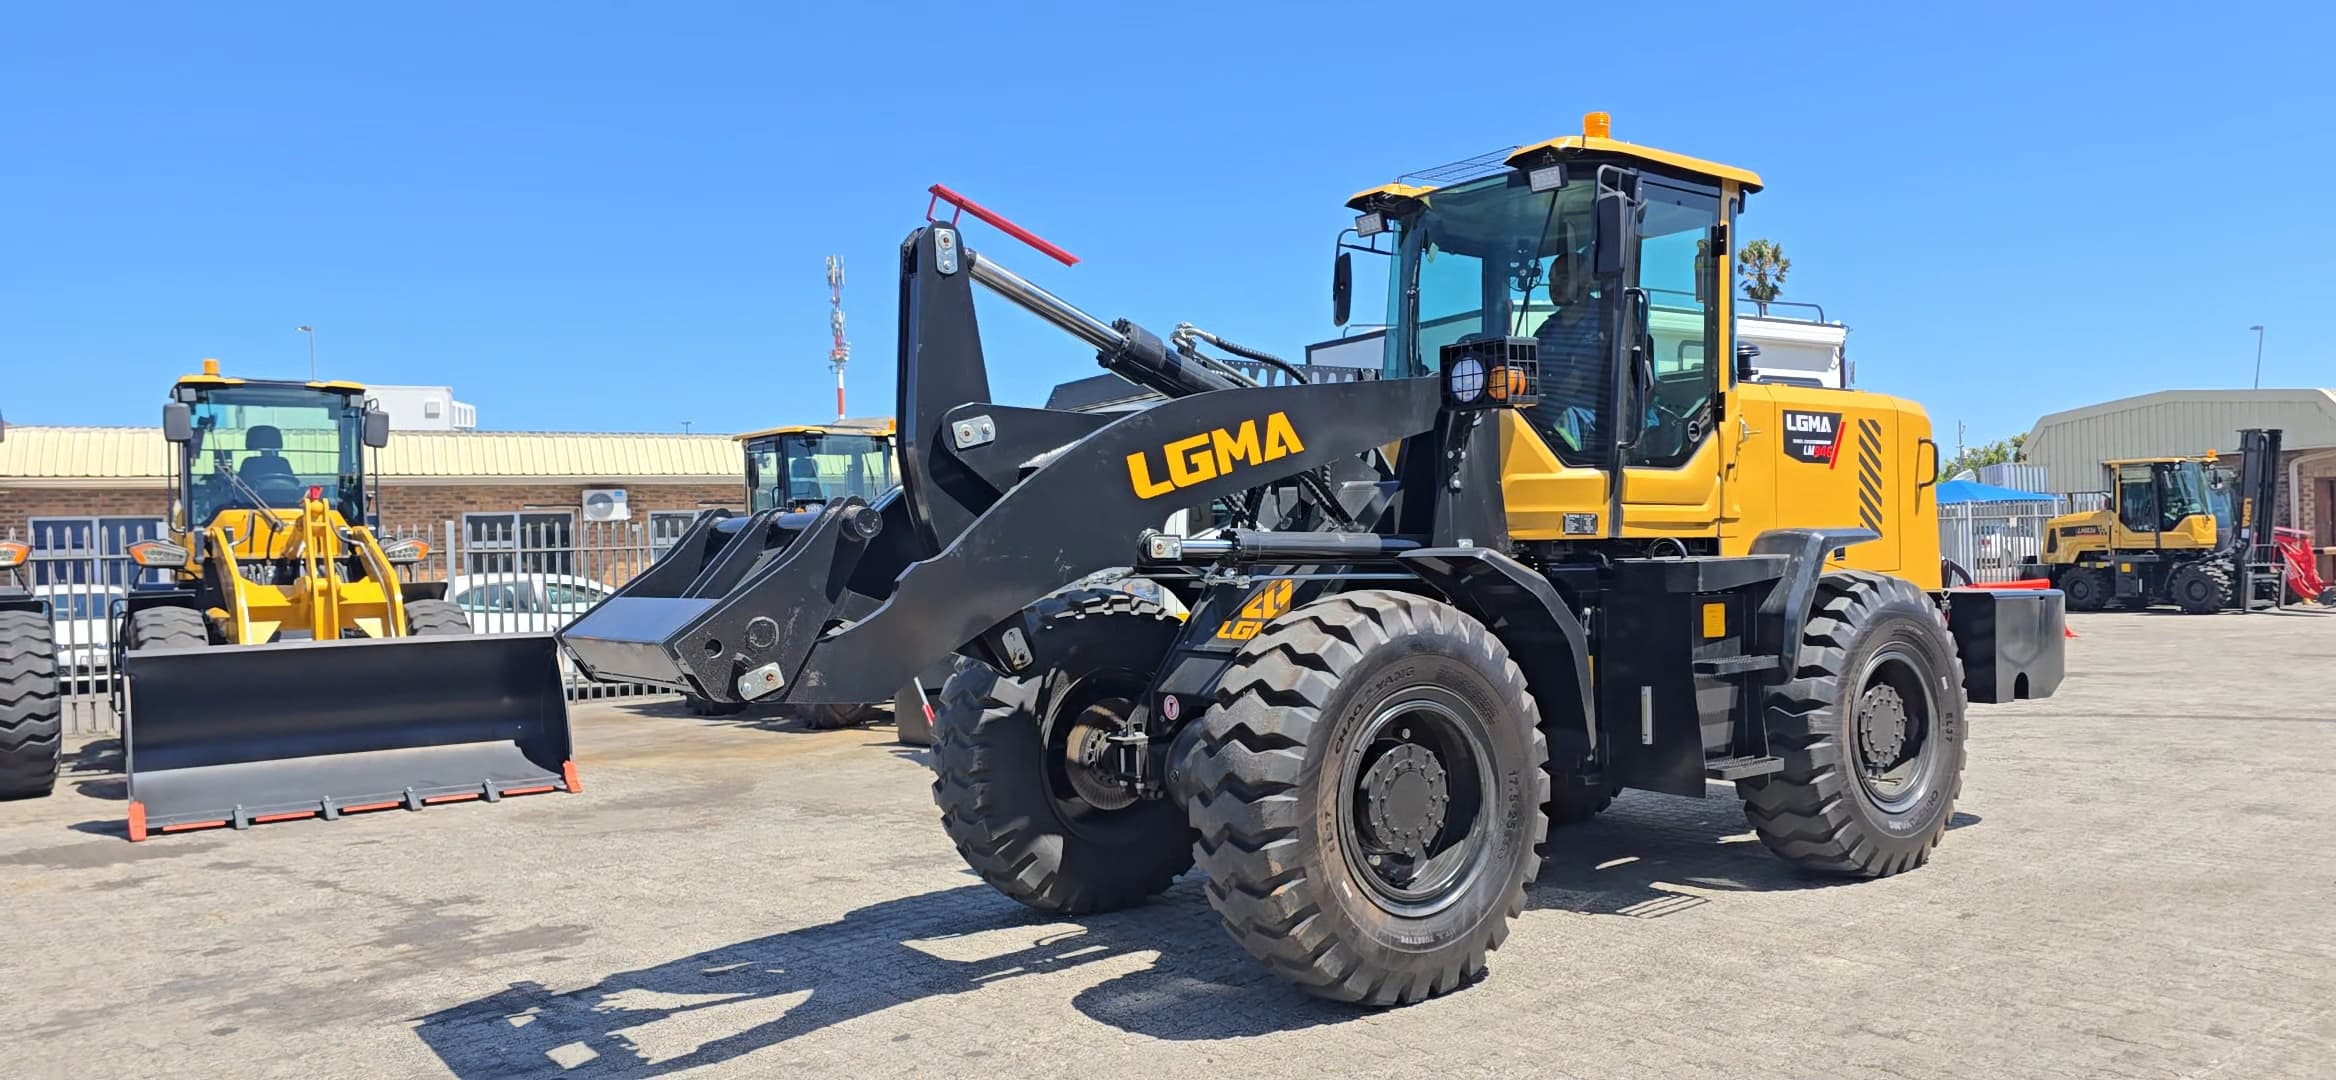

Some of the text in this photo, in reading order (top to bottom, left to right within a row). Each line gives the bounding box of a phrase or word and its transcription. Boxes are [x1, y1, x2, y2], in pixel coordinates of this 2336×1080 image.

[1786, 414, 1832, 432] LGMA
[1126, 411, 1305, 499] LGMA
[1216, 620, 1263, 640] LG
